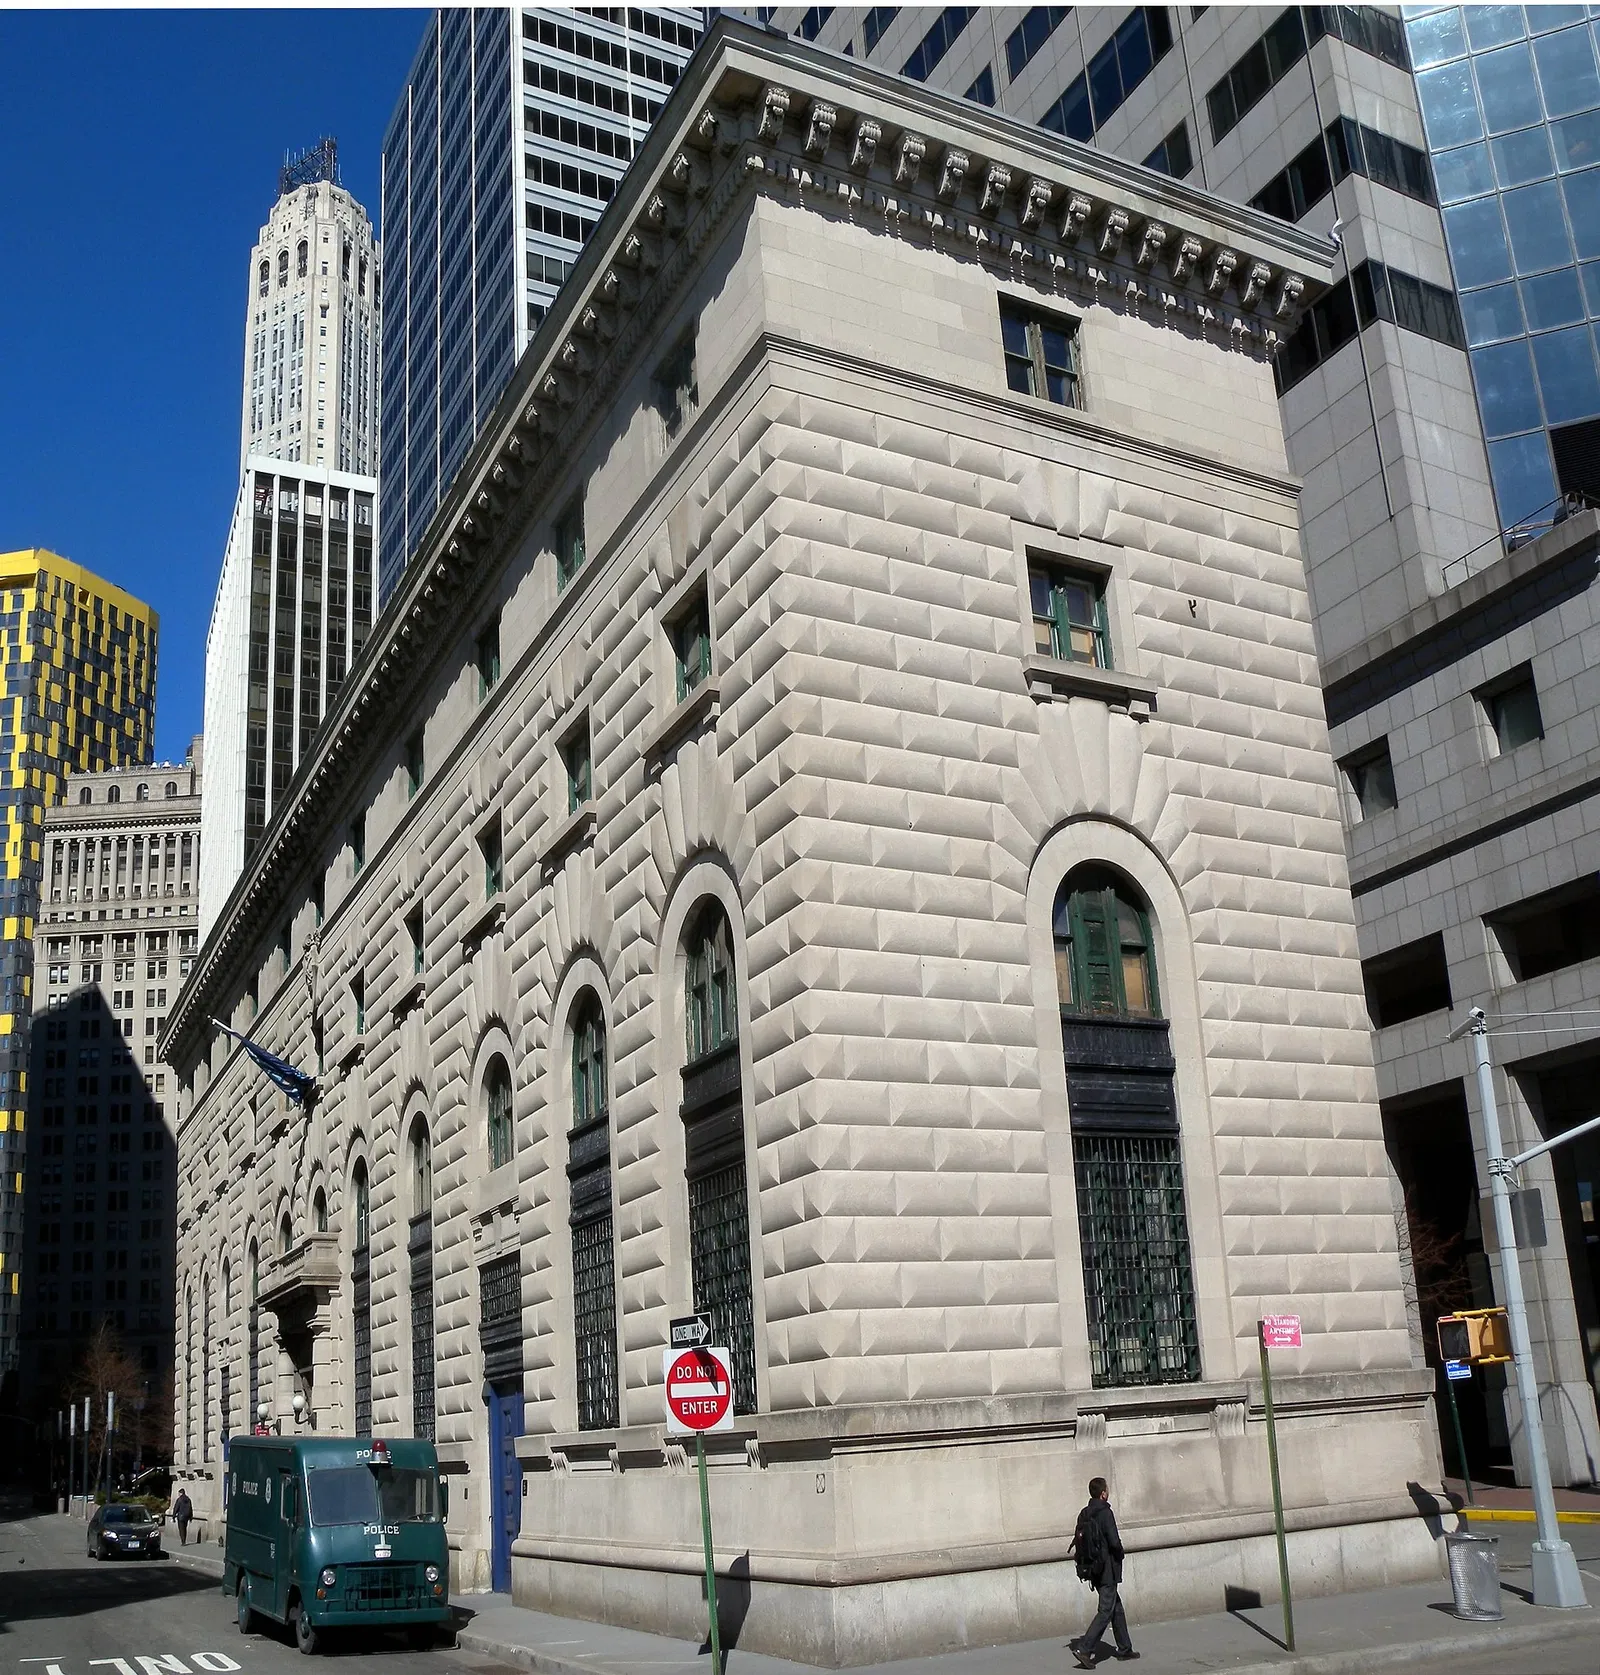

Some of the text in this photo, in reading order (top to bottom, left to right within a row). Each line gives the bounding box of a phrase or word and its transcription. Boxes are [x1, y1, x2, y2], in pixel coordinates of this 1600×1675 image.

[675, 1324, 705, 1340] ONE WAY
[1269, 1327, 1295, 1335] ANYTIME
[676, 1365, 718, 1379] DO NOT
[682, 1401, 718, 1415] ENTER
[363, 1525, 400, 1535] POLICE
